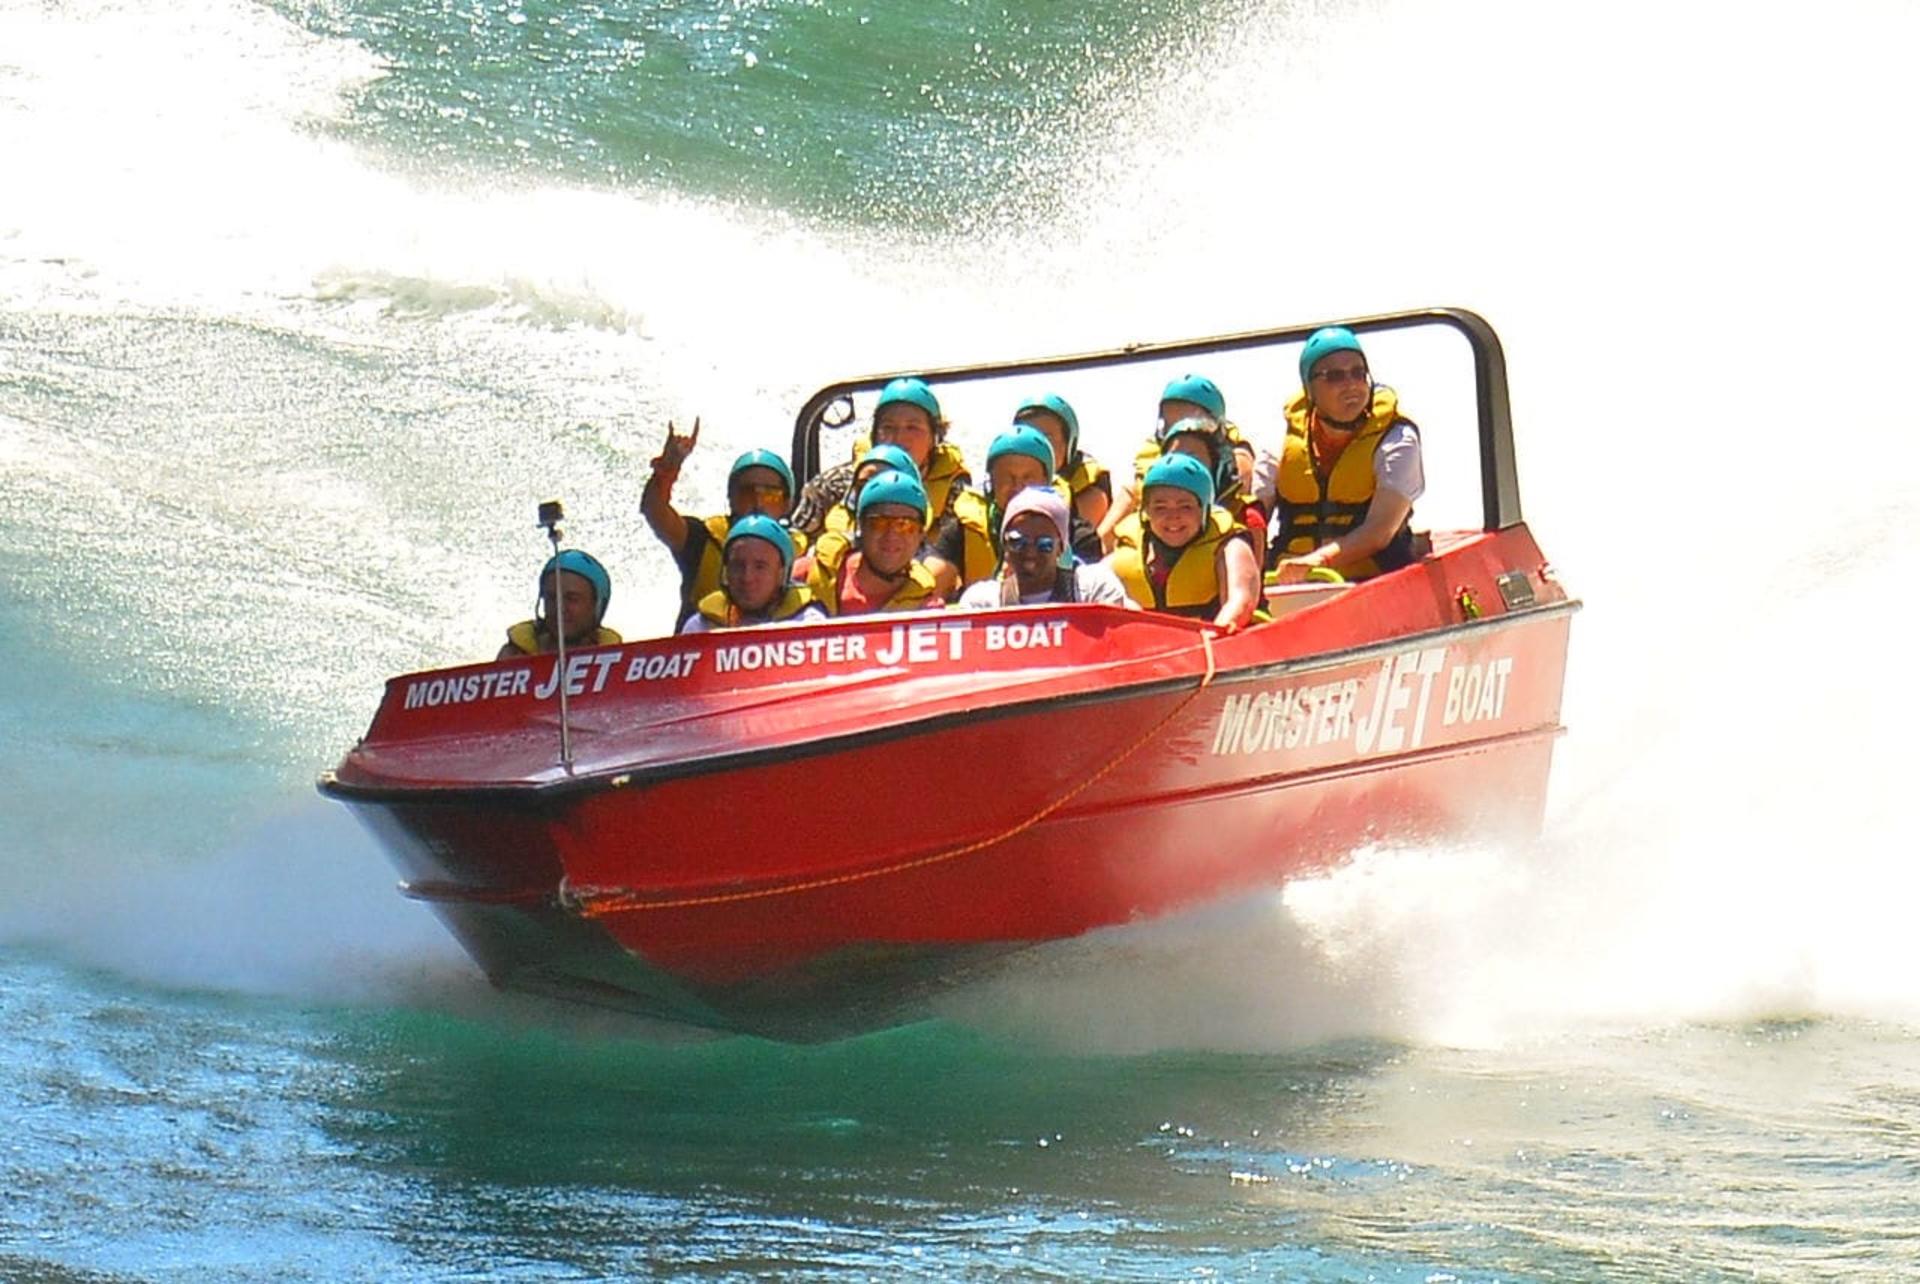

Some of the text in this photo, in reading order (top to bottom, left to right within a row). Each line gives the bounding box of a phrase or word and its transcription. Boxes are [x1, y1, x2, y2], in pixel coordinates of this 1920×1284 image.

[714, 620, 1068, 673] MONSTER JET BOAT
[404, 652, 700, 709] MONSTER JET BOAT
[1212, 649, 1512, 755] MONSTER JET BOAT
